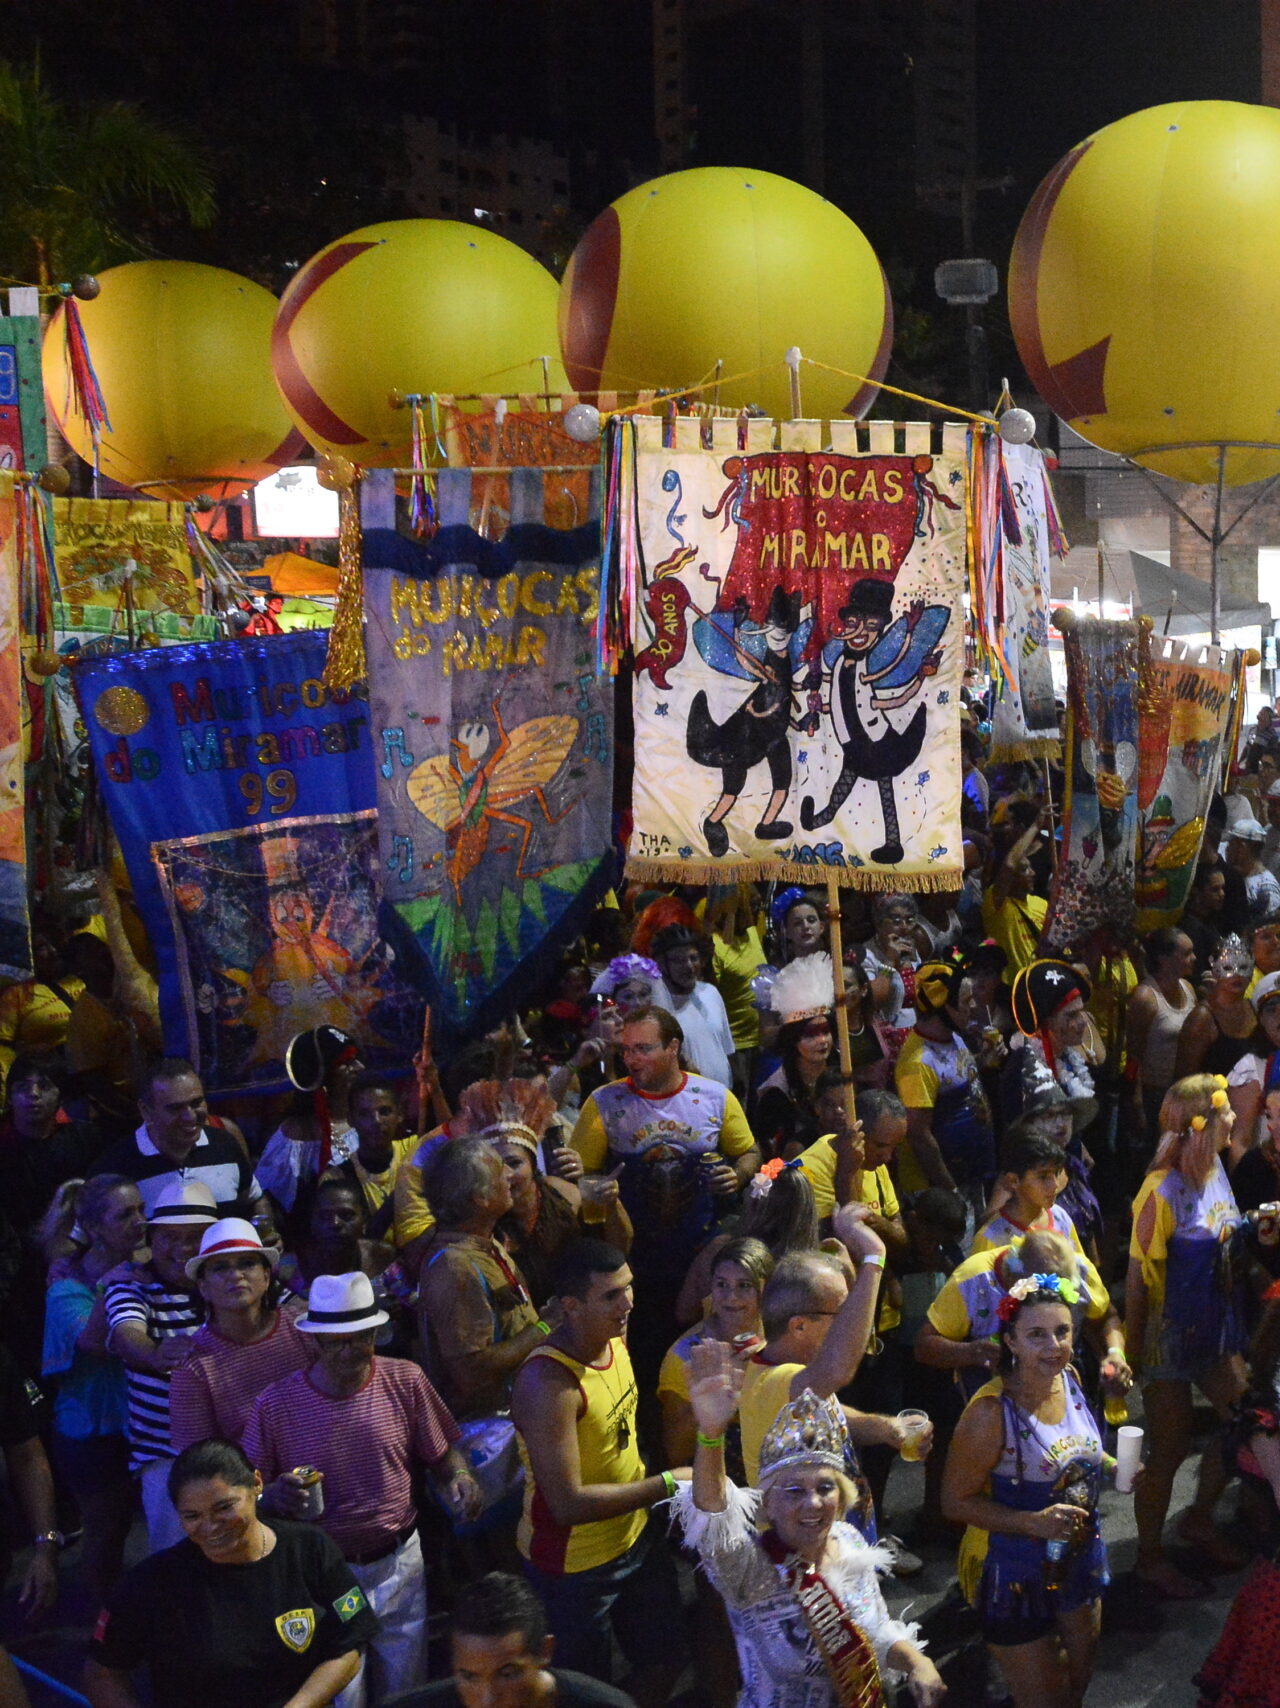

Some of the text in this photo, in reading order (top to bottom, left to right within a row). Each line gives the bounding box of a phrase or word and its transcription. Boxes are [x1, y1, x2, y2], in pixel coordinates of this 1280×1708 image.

[759, 529, 893, 571] MIRAMAR
[393, 626, 432, 660] do
[649, 591, 679, 665] 30 ANOS
[104, 717, 368, 783] do Miramar
[239, 769, 297, 815] 99
[639, 831, 671, 847] THA
